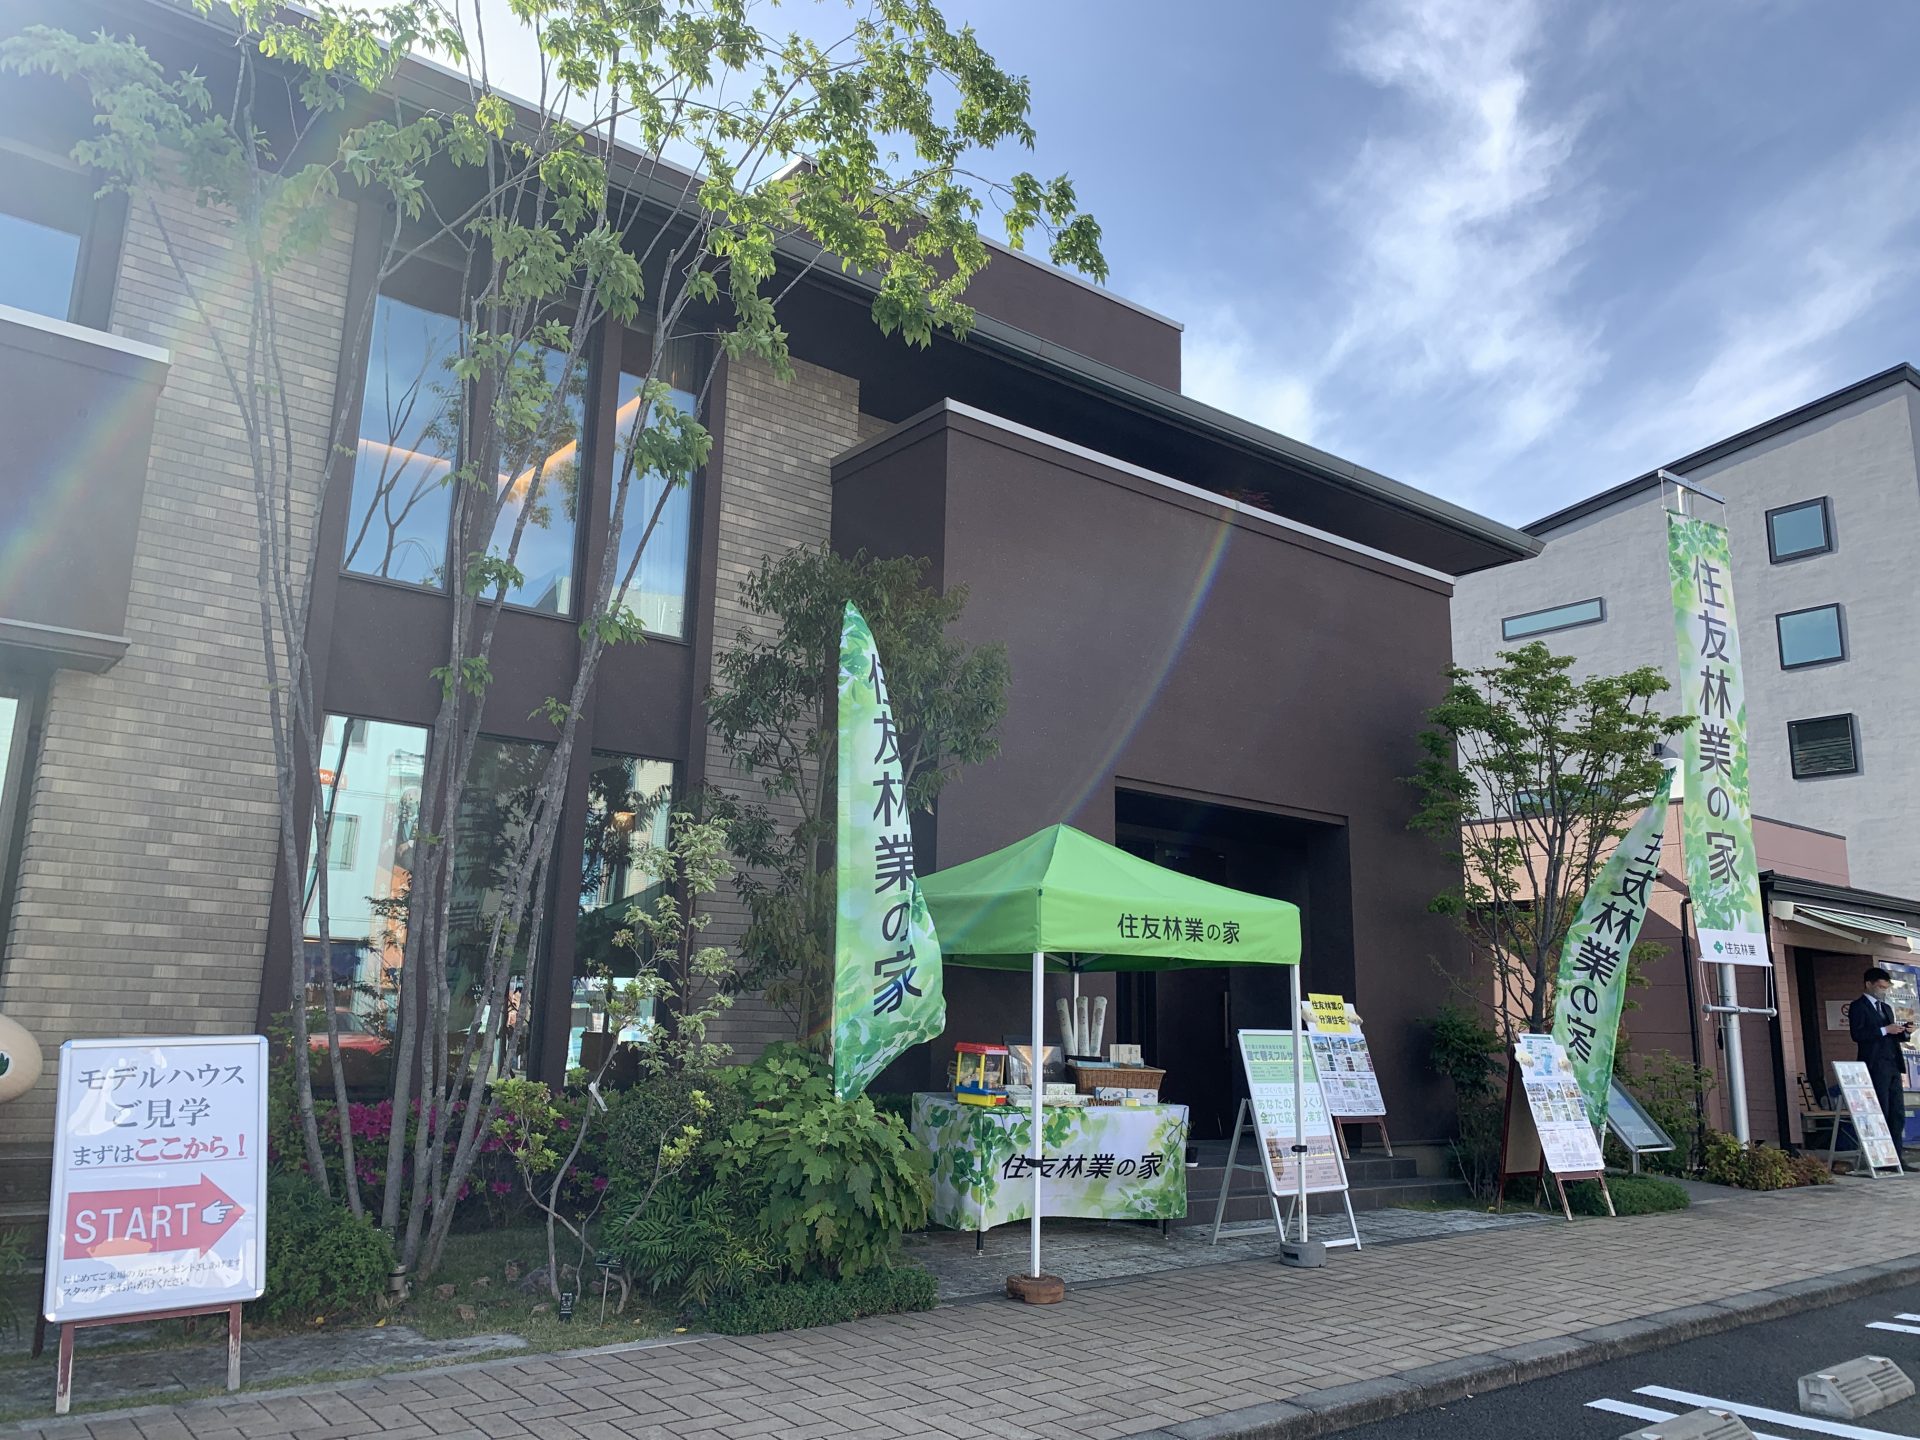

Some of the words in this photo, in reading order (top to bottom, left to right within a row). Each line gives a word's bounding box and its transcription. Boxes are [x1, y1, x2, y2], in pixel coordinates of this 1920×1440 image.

[1693, 555, 1740, 883] 住友林業の家
[1117, 913, 1240, 944] 住友林業の家
[1725, 942, 1756, 955] 住友林業
[1312, 1001, 1344, 1011] 住友林業の
[78, 1063, 245, 1091] モデルハウス
[113, 1096, 211, 1129] ご見学
[73, 1202, 197, 1245] START
